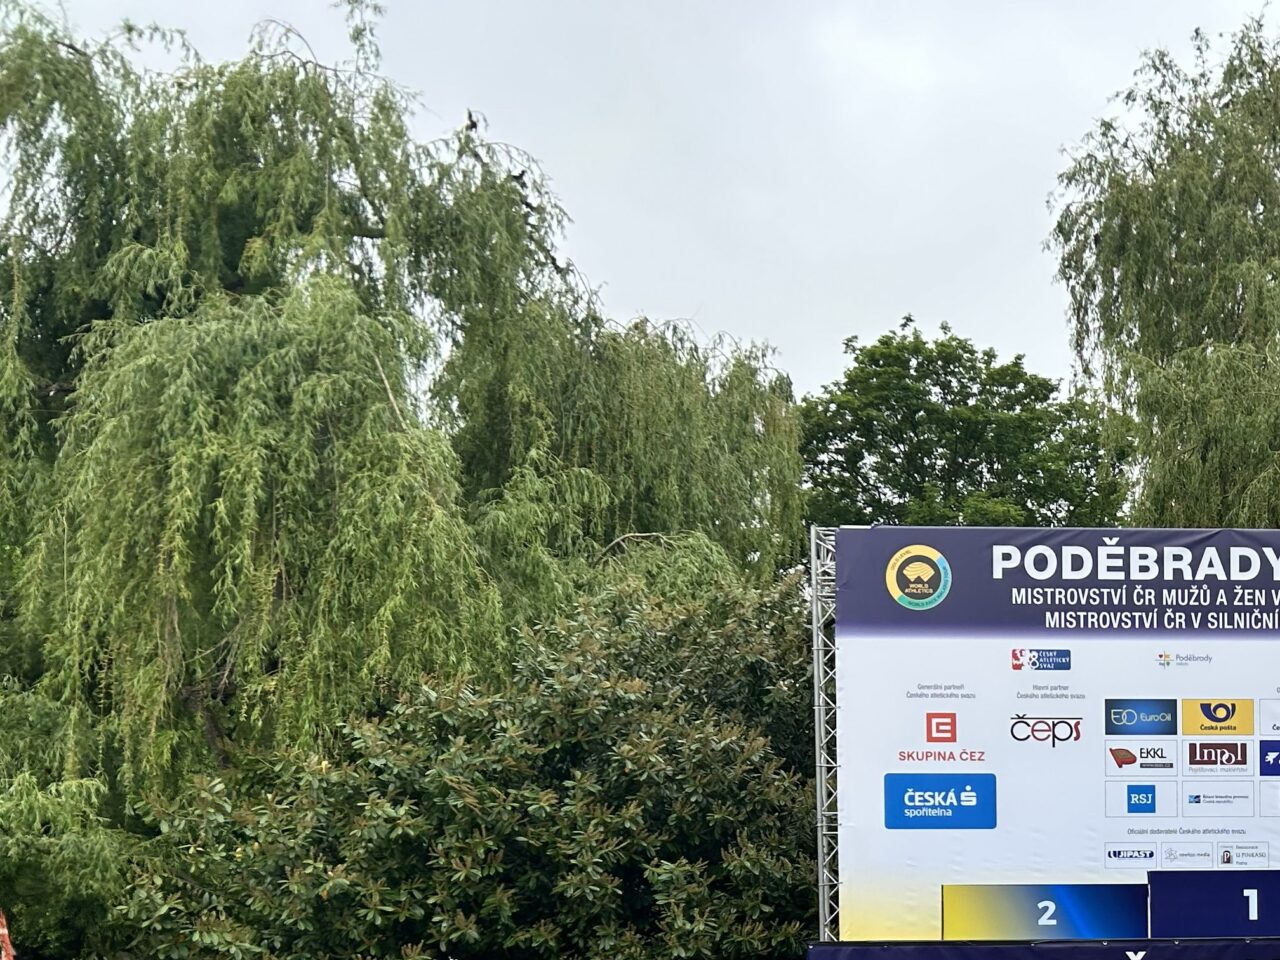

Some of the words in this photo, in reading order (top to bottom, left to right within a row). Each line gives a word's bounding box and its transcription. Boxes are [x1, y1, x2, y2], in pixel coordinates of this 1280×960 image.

[1011, 585, 1127, 606] MISTROVSTVÍ
[1132, 584, 1157, 606] ČR
[1162, 584, 1211, 606] MUŽŮ
[1216, 589, 1229, 606] A
[1233, 585, 1266, 607] ŽEN
[1044, 608, 1158, 629] MISTROVSTVÍ
[1163, 608, 1187, 629] ČR
[1190, 612, 1202, 629] V
[1139, 712, 1172, 722] EuroOil
[1199, 723, 1219, 731] Česká
[1219, 724, 1237, 732] pošta
[898, 750, 956, 762] SKUPINA
[959, 748, 985, 762] ČEZ
[1139, 747, 1167, 759] EKKL
[903, 787, 958, 806] ČESKÁ
[1130, 793, 1153, 804] RSJ
[904, 806, 953, 818] spořitelna
[1242, 889, 1259, 921] 1
[1037, 900, 1058, 926] 2
